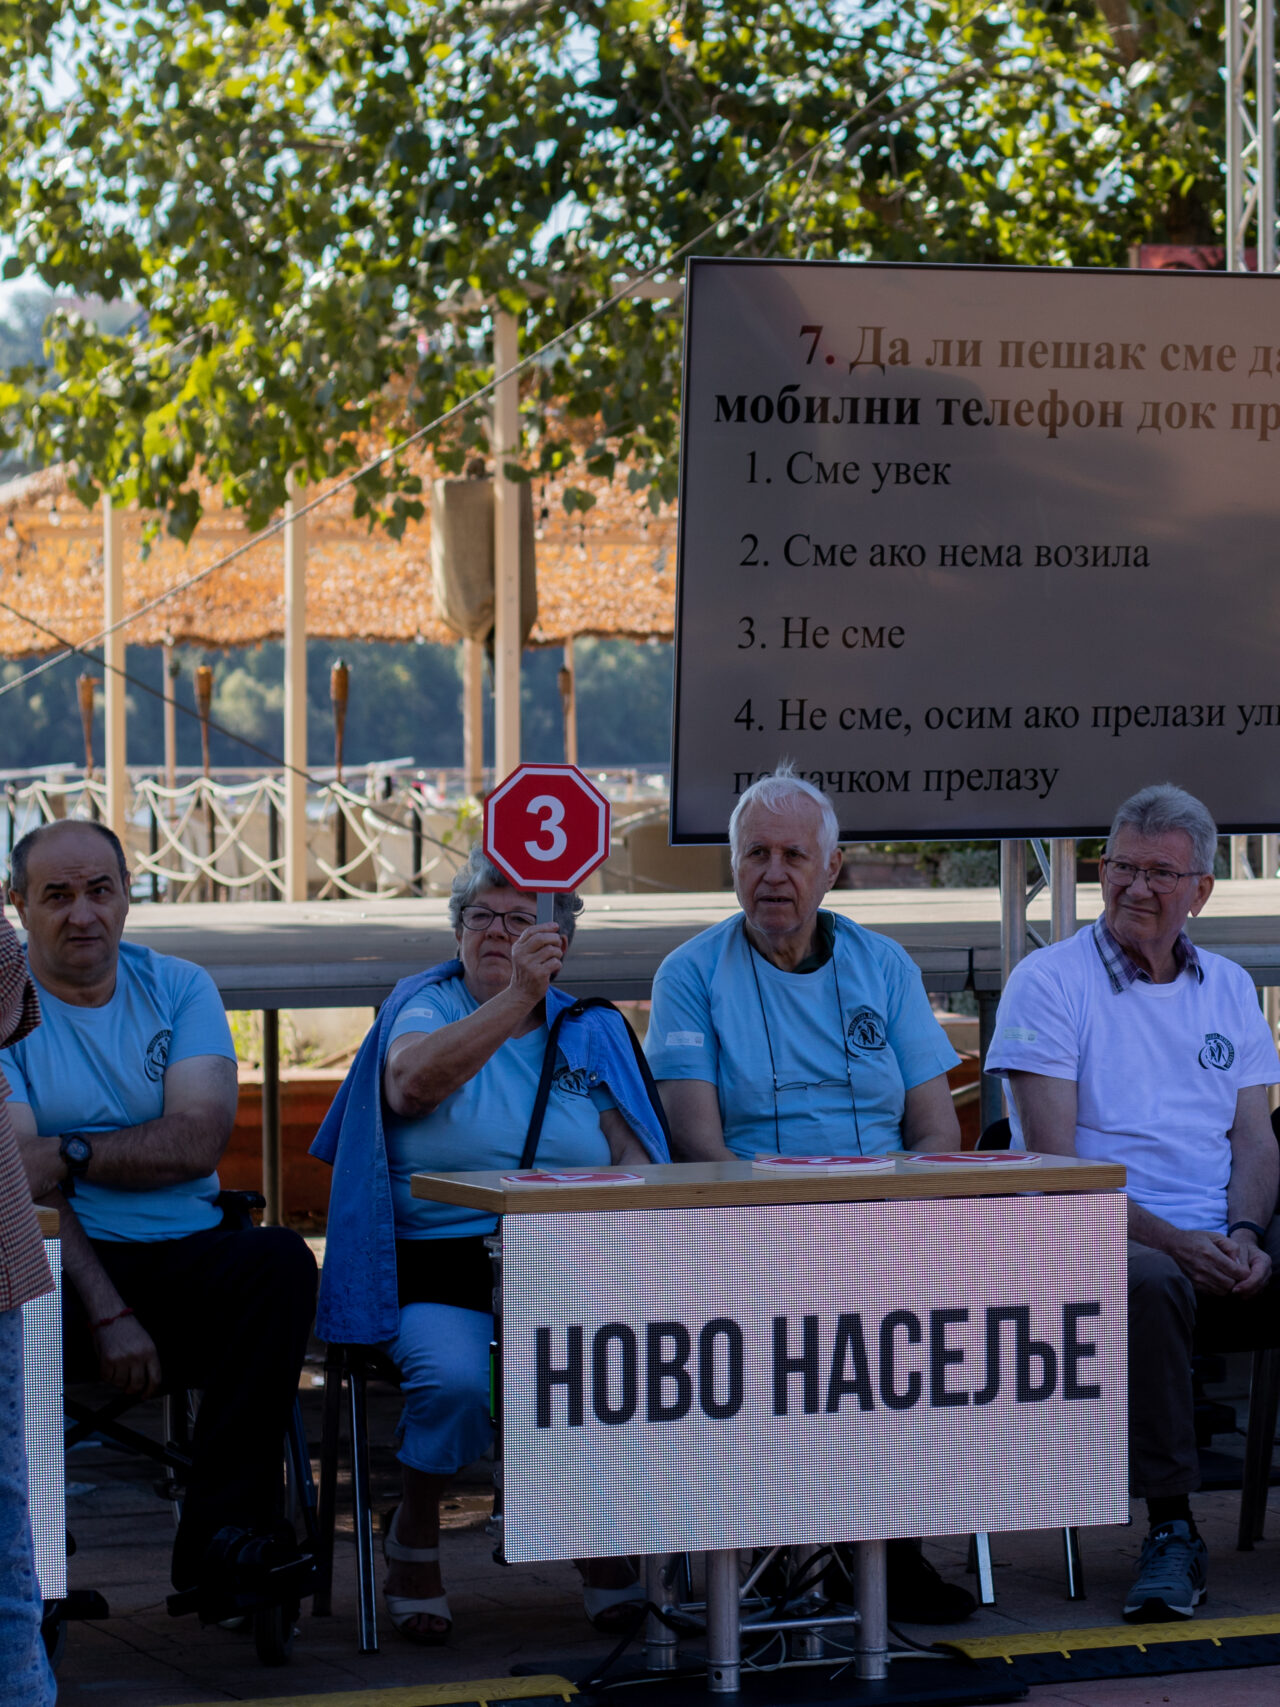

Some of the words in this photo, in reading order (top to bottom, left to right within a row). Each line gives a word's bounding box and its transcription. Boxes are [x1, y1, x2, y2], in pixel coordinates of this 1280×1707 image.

[800, 325, 835, 366] 7.
[849, 326, 910, 375] Да
[925, 339, 982, 367] ли
[998, 340, 1146, 370] пешак
[1160, 342, 1237, 372] сме
[714, 384, 920, 426] мобилни
[936, 388, 1123, 439] телефон
[1137, 401, 1217, 434] док
[745, 451, 772, 485] 1.
[786, 451, 860, 486] Сме
[871, 460, 952, 494] увек
[739, 533, 769, 567] 2.
[783, 533, 857, 567] Сме
[869, 542, 926, 567] ако
[938, 543, 1024, 568] нема
[1035, 544, 1151, 568] возила
[737, 616, 766, 649] 3.
[780, 616, 829, 649] Не
[842, 624, 905, 649] сме
[734, 698, 764, 731] 4.
[778, 698, 827, 731] Не
[839, 706, 912, 736] сме,
[925, 705, 1012, 730] осим
[1024, 704, 1080, 729] ако
[1091, 704, 1226, 736] прелази
[733, 769, 910, 794] пачком
[922, 766, 1060, 800] прелазу
[524, 794, 568, 862] 3
[535, 1316, 744, 1429] НОВО
[772, 1301, 1102, 1416] НАСЕЉЕ
